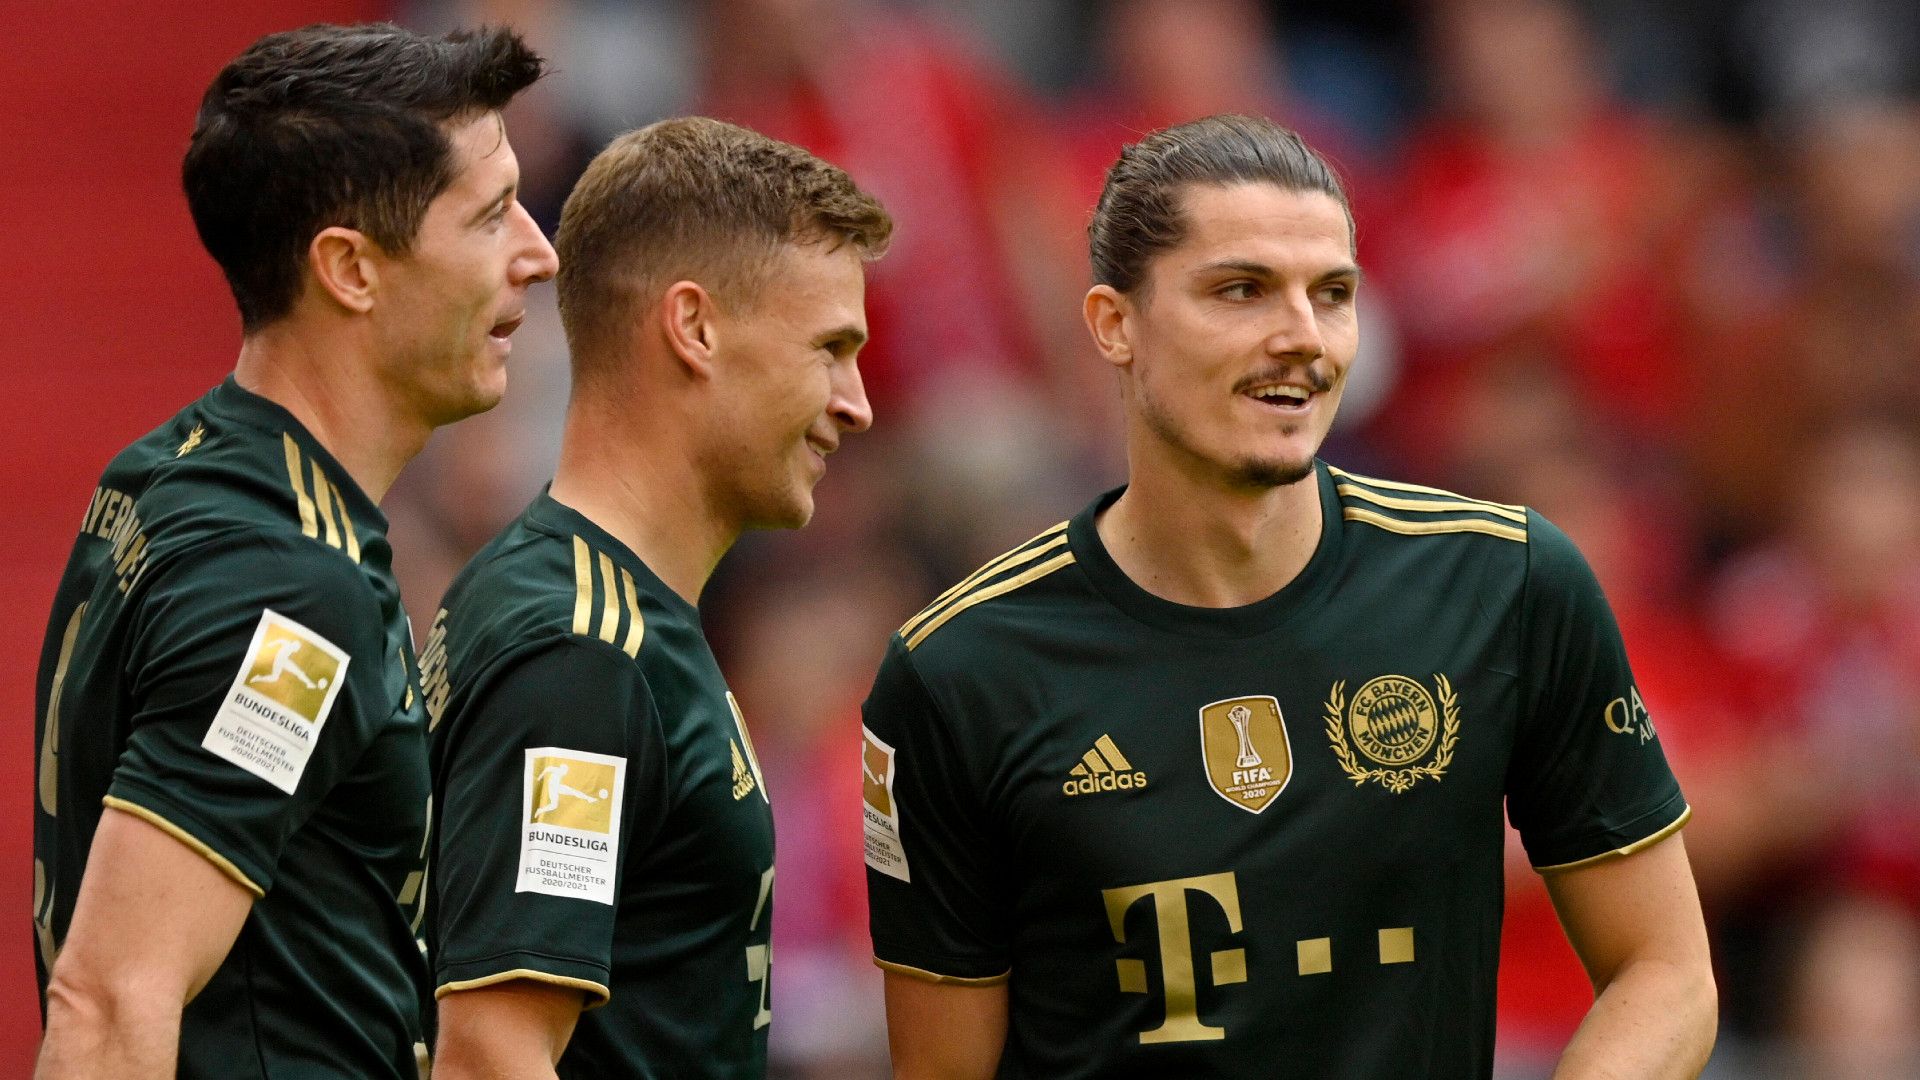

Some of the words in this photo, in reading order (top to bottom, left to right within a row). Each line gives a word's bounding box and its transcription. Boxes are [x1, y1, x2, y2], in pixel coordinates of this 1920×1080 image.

[1355, 696, 1371, 716] FC
[1371, 682, 1429, 712] BAYERN
[1604, 685, 1647, 734] QA
[235, 693, 310, 740] BUNDESLIGA
[219, 728, 295, 771] FUSSBALLMEISTER
[237, 726, 287, 756] DEUTSCHER
[232, 744, 276, 772] 2020/2021
[1063, 770, 1147, 795] adidas
[1232, 767, 1271, 785] FIFA
[1247, 780, 1281, 789] CHAMPIONS
[1242, 788, 1266, 799] 2020
[864, 808, 894, 833] DESLIGA
[528, 831, 608, 852] BUNDESLIGA
[525, 867, 606, 885] FUSSBALLMEISTER
[540, 859, 592, 874] DEUTSCHER
[542, 877, 588, 891] 2020/2021
